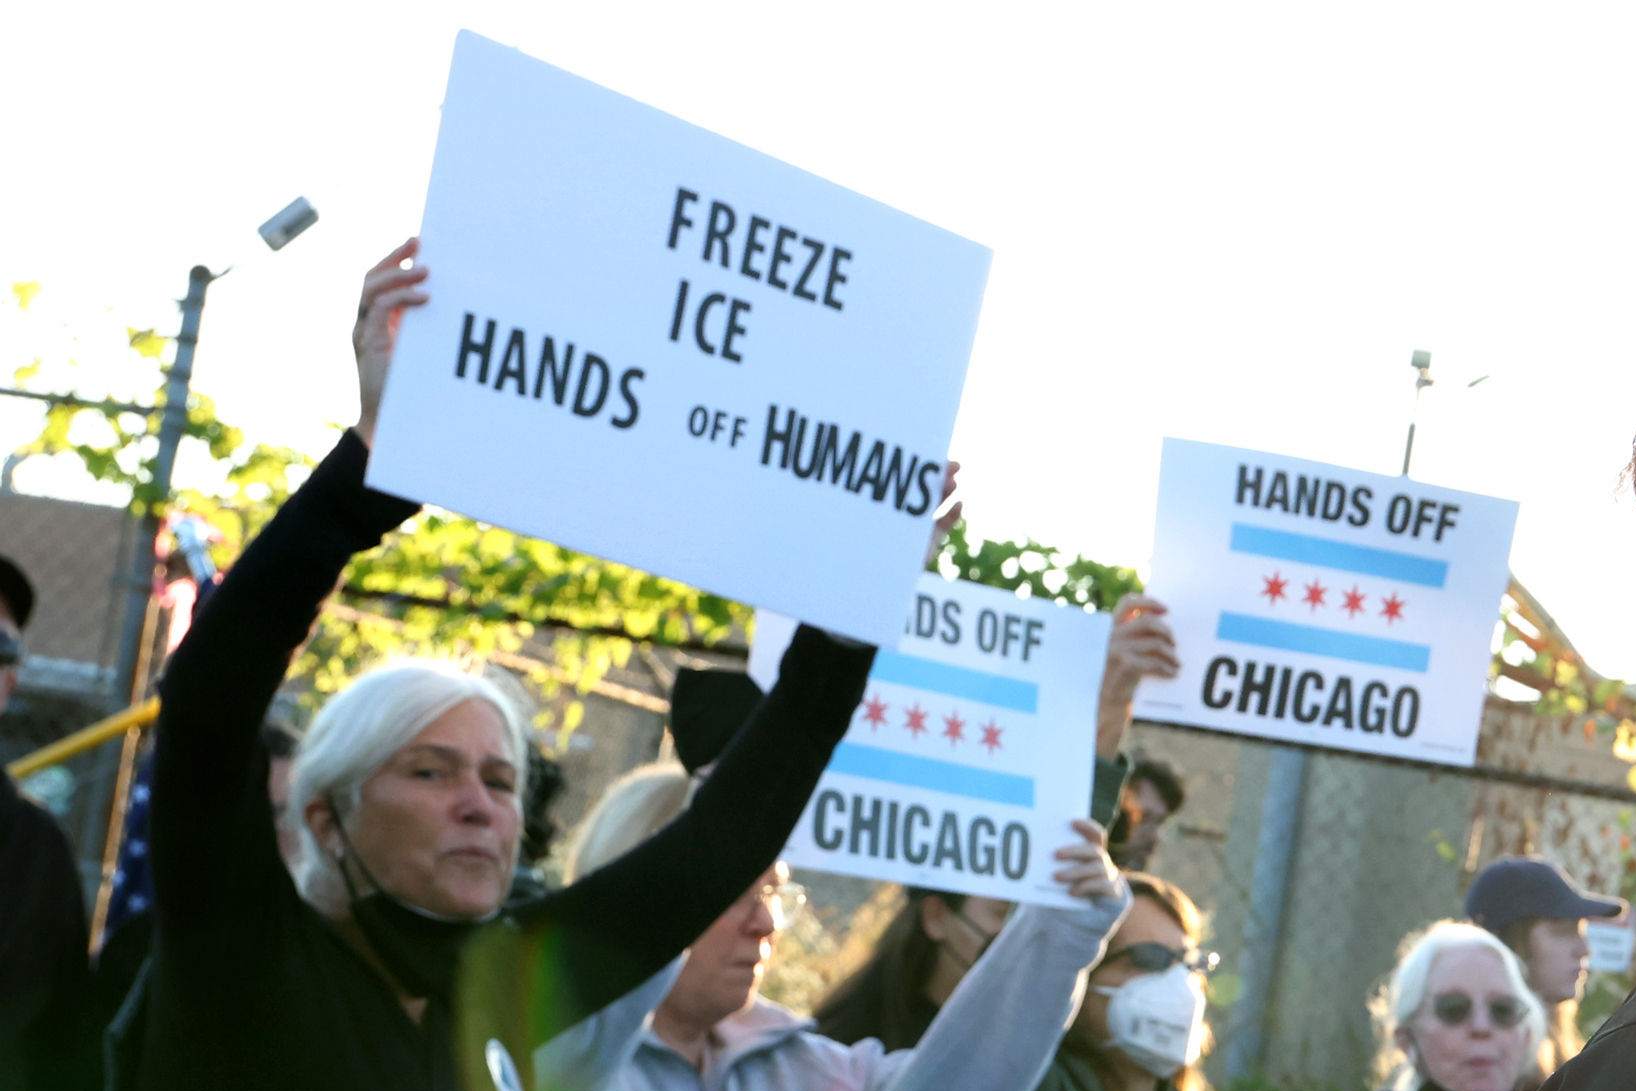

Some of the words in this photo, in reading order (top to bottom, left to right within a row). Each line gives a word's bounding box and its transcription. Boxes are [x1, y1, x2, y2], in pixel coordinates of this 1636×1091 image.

[667, 187, 853, 312] FREEZE
[669, 280, 752, 364] ICE
[455, 313, 646, 429] HANDS
[688, 406, 747, 448] OFF
[761, 404, 941, 517] HUMANS
[1235, 464, 1372, 528] HANDS
[1386, 494, 1461, 544] OFF
[906, 594, 962, 645] DS
[977, 608, 1044, 661] OFF
[1202, 656, 1421, 740] CHICAGO
[813, 788, 1029, 881] CHICAGO
